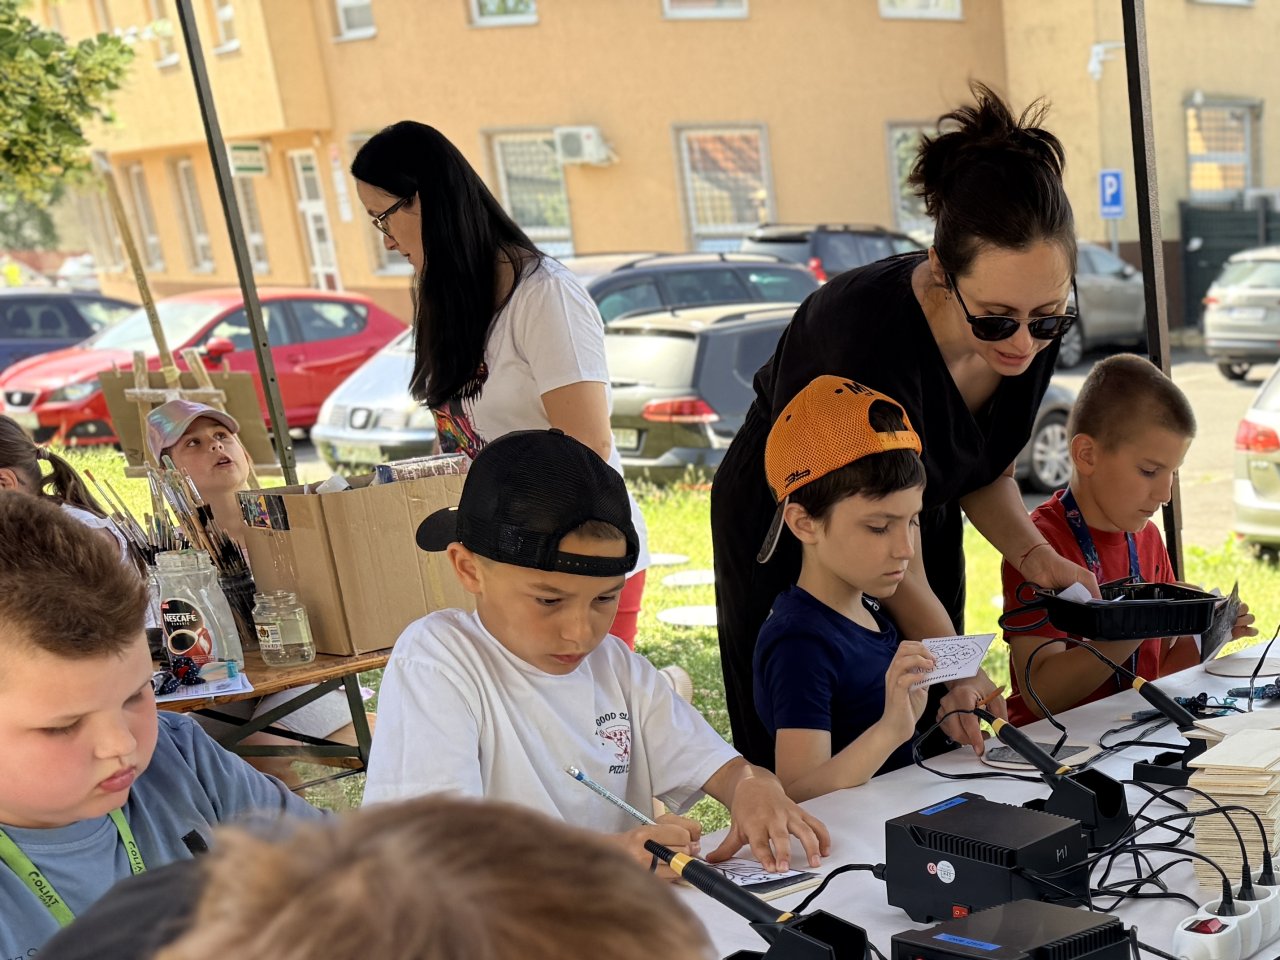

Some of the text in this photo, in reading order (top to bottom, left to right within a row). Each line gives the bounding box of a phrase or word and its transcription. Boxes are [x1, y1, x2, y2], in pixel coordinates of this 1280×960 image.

[1103, 175, 1118, 203] P
[595, 712, 617, 727] GOOD
[128, 840, 144, 872] GOLIA
